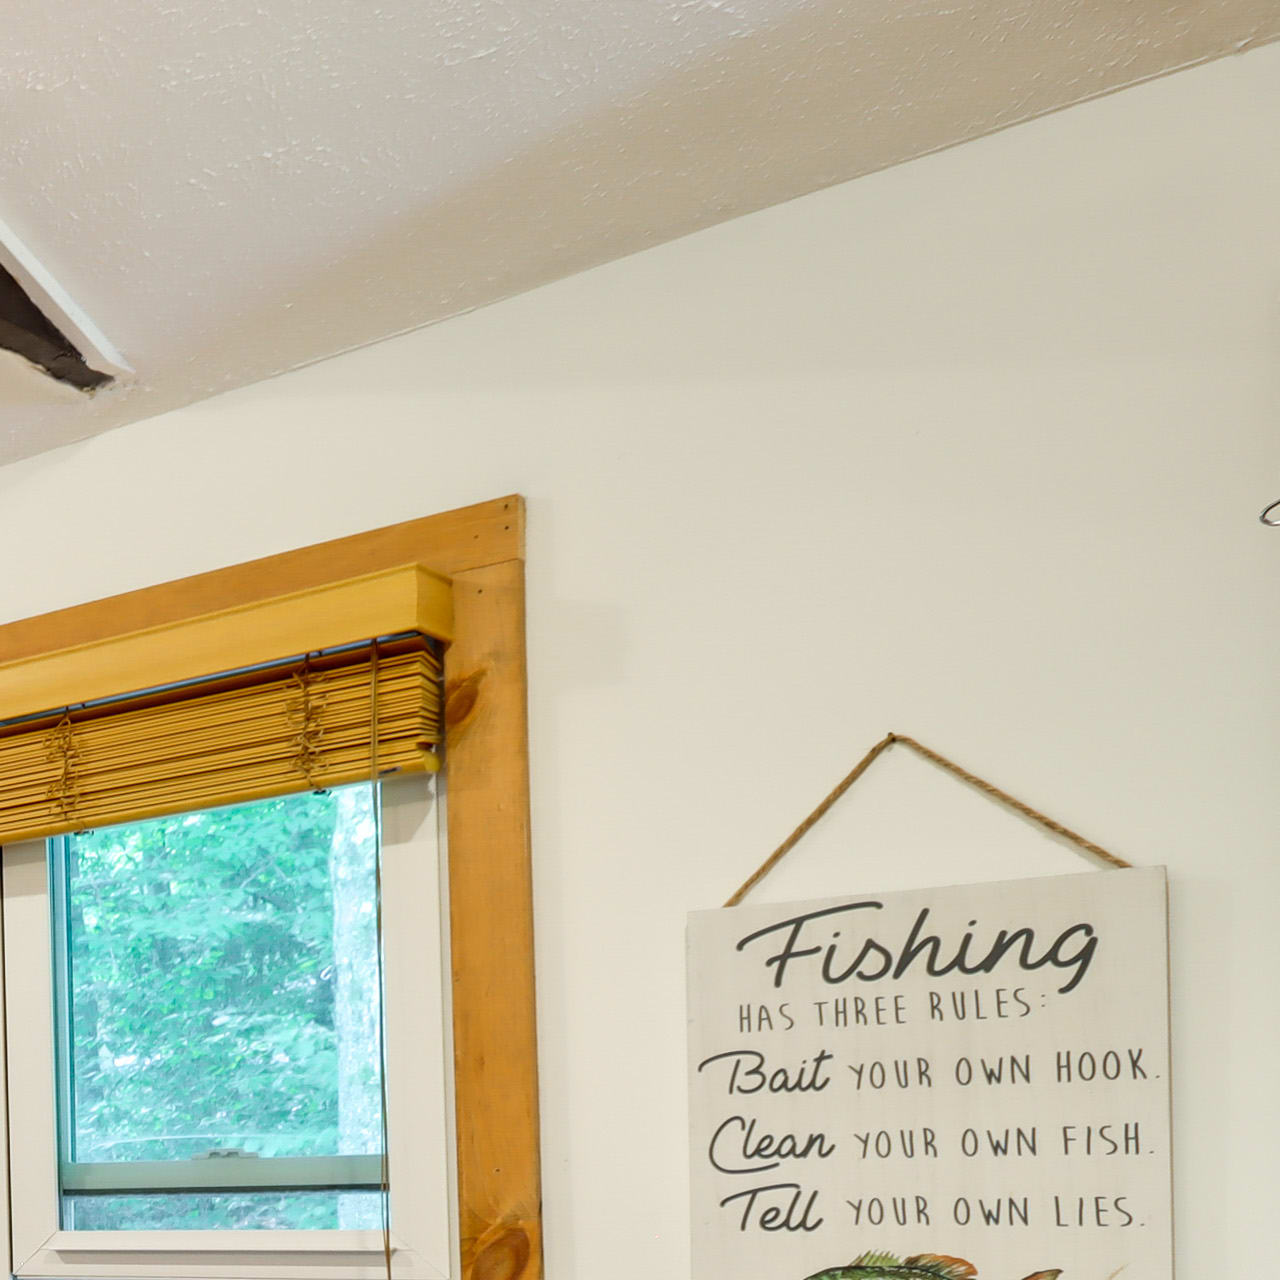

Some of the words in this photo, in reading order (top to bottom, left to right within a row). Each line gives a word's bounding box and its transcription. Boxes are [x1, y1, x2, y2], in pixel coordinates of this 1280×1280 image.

[736, 901, 1099, 994] Fishing
[739, 1002, 795, 1033] HAS
[814, 994, 907, 1028] THREE
[929, 986, 1048, 1022] RULES:
[698, 1049, 834, 1094] Bait
[848, 1057, 933, 1091] YOUR
[955, 1054, 1032, 1086] OWN
[1056, 1048, 1162, 1083] HOOK.
[708, 1115, 836, 1174] Clean
[853, 1127, 939, 1159] YOUR
[961, 1126, 1038, 1157] OWN
[1062, 1122, 1155, 1156] FISH.
[720, 1183, 824, 1232] Tell
[846, 1196, 931, 1227] YOUR
[953, 1196, 1031, 1227] OWN
[1054, 1195, 1146, 1228] LIES.
